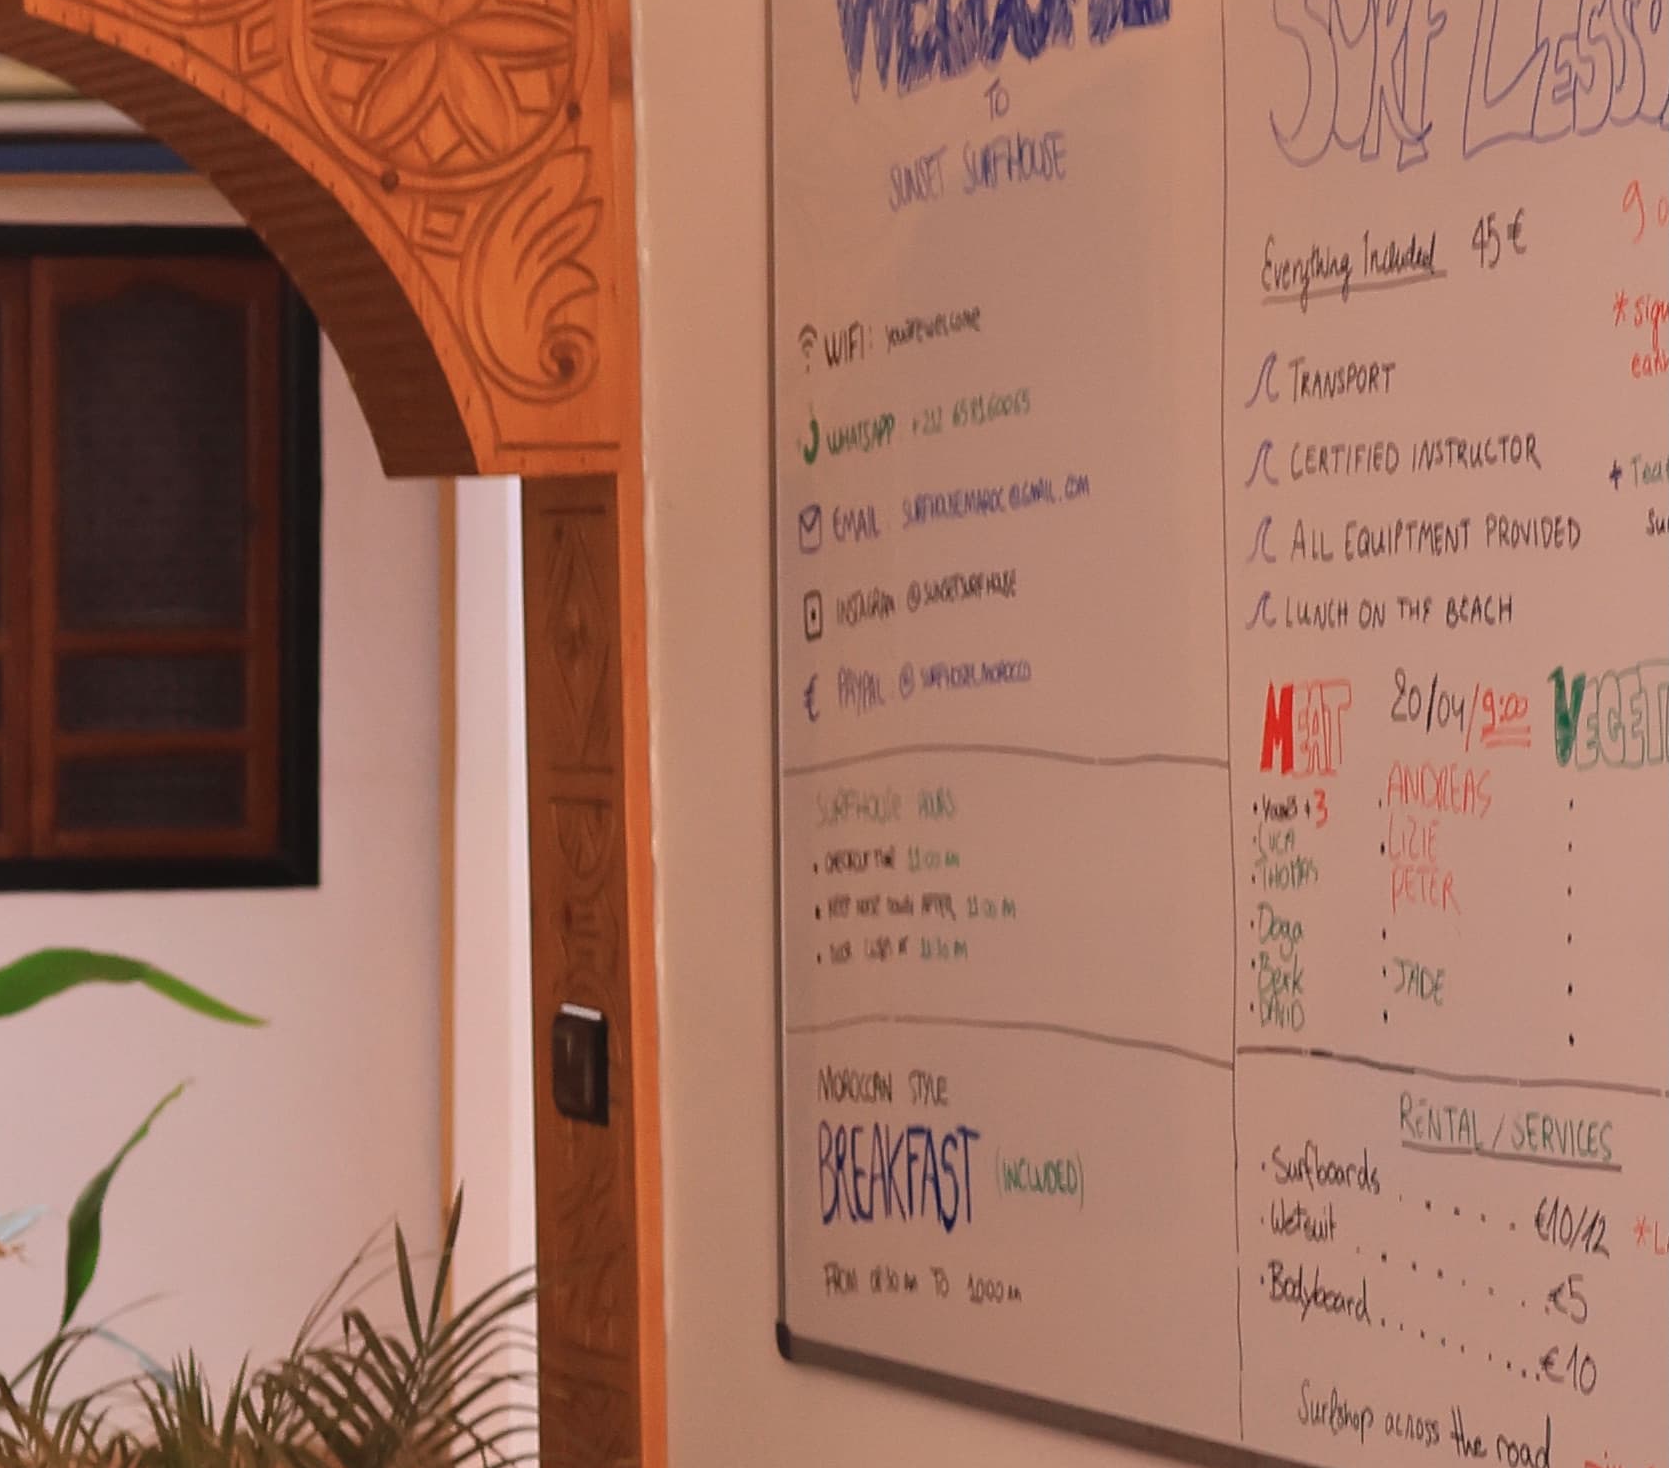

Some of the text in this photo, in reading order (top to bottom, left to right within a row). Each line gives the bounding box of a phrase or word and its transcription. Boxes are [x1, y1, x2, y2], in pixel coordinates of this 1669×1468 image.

[984, 78, 1009, 120] TO
[1261, 232, 1352, 315] Everything
[1363, 229, 1436, 277] Included
[1288, 355, 1397, 404] TRANSPORT
[827, 413, 896, 456] WHATSAPP
[1290, 433, 1542, 481] CERTIFIED INSTRUCTOR
[832, 505, 881, 543] EMAIL
[1290, 511, 1582, 562] ALL EQUIPTMENT PROVIDED
[1285, 593, 1514, 630] LUNCH ON THE BEACH
[837, 664, 886, 716] PAYPAL
[1260, 678, 1352, 778] MEAT
[1313, 788, 1328, 829] 3
[1387, 759, 1493, 819] ANDREAS
[1389, 865, 1461, 916] PETER
[1393, 956, 1446, 1006] JADE
[818, 1065, 949, 1106] MOROCCAN STYLE
[1511, 1112, 1614, 1162] SERVICES
[818, 1119, 980, 1234] BREAKFAST
[1271, 1139, 1611, 1260] Surfboards €10/12
[1268, 1259, 1598, 1396] Bodyboard €10
[1450, 1404, 1488, 1458] the
